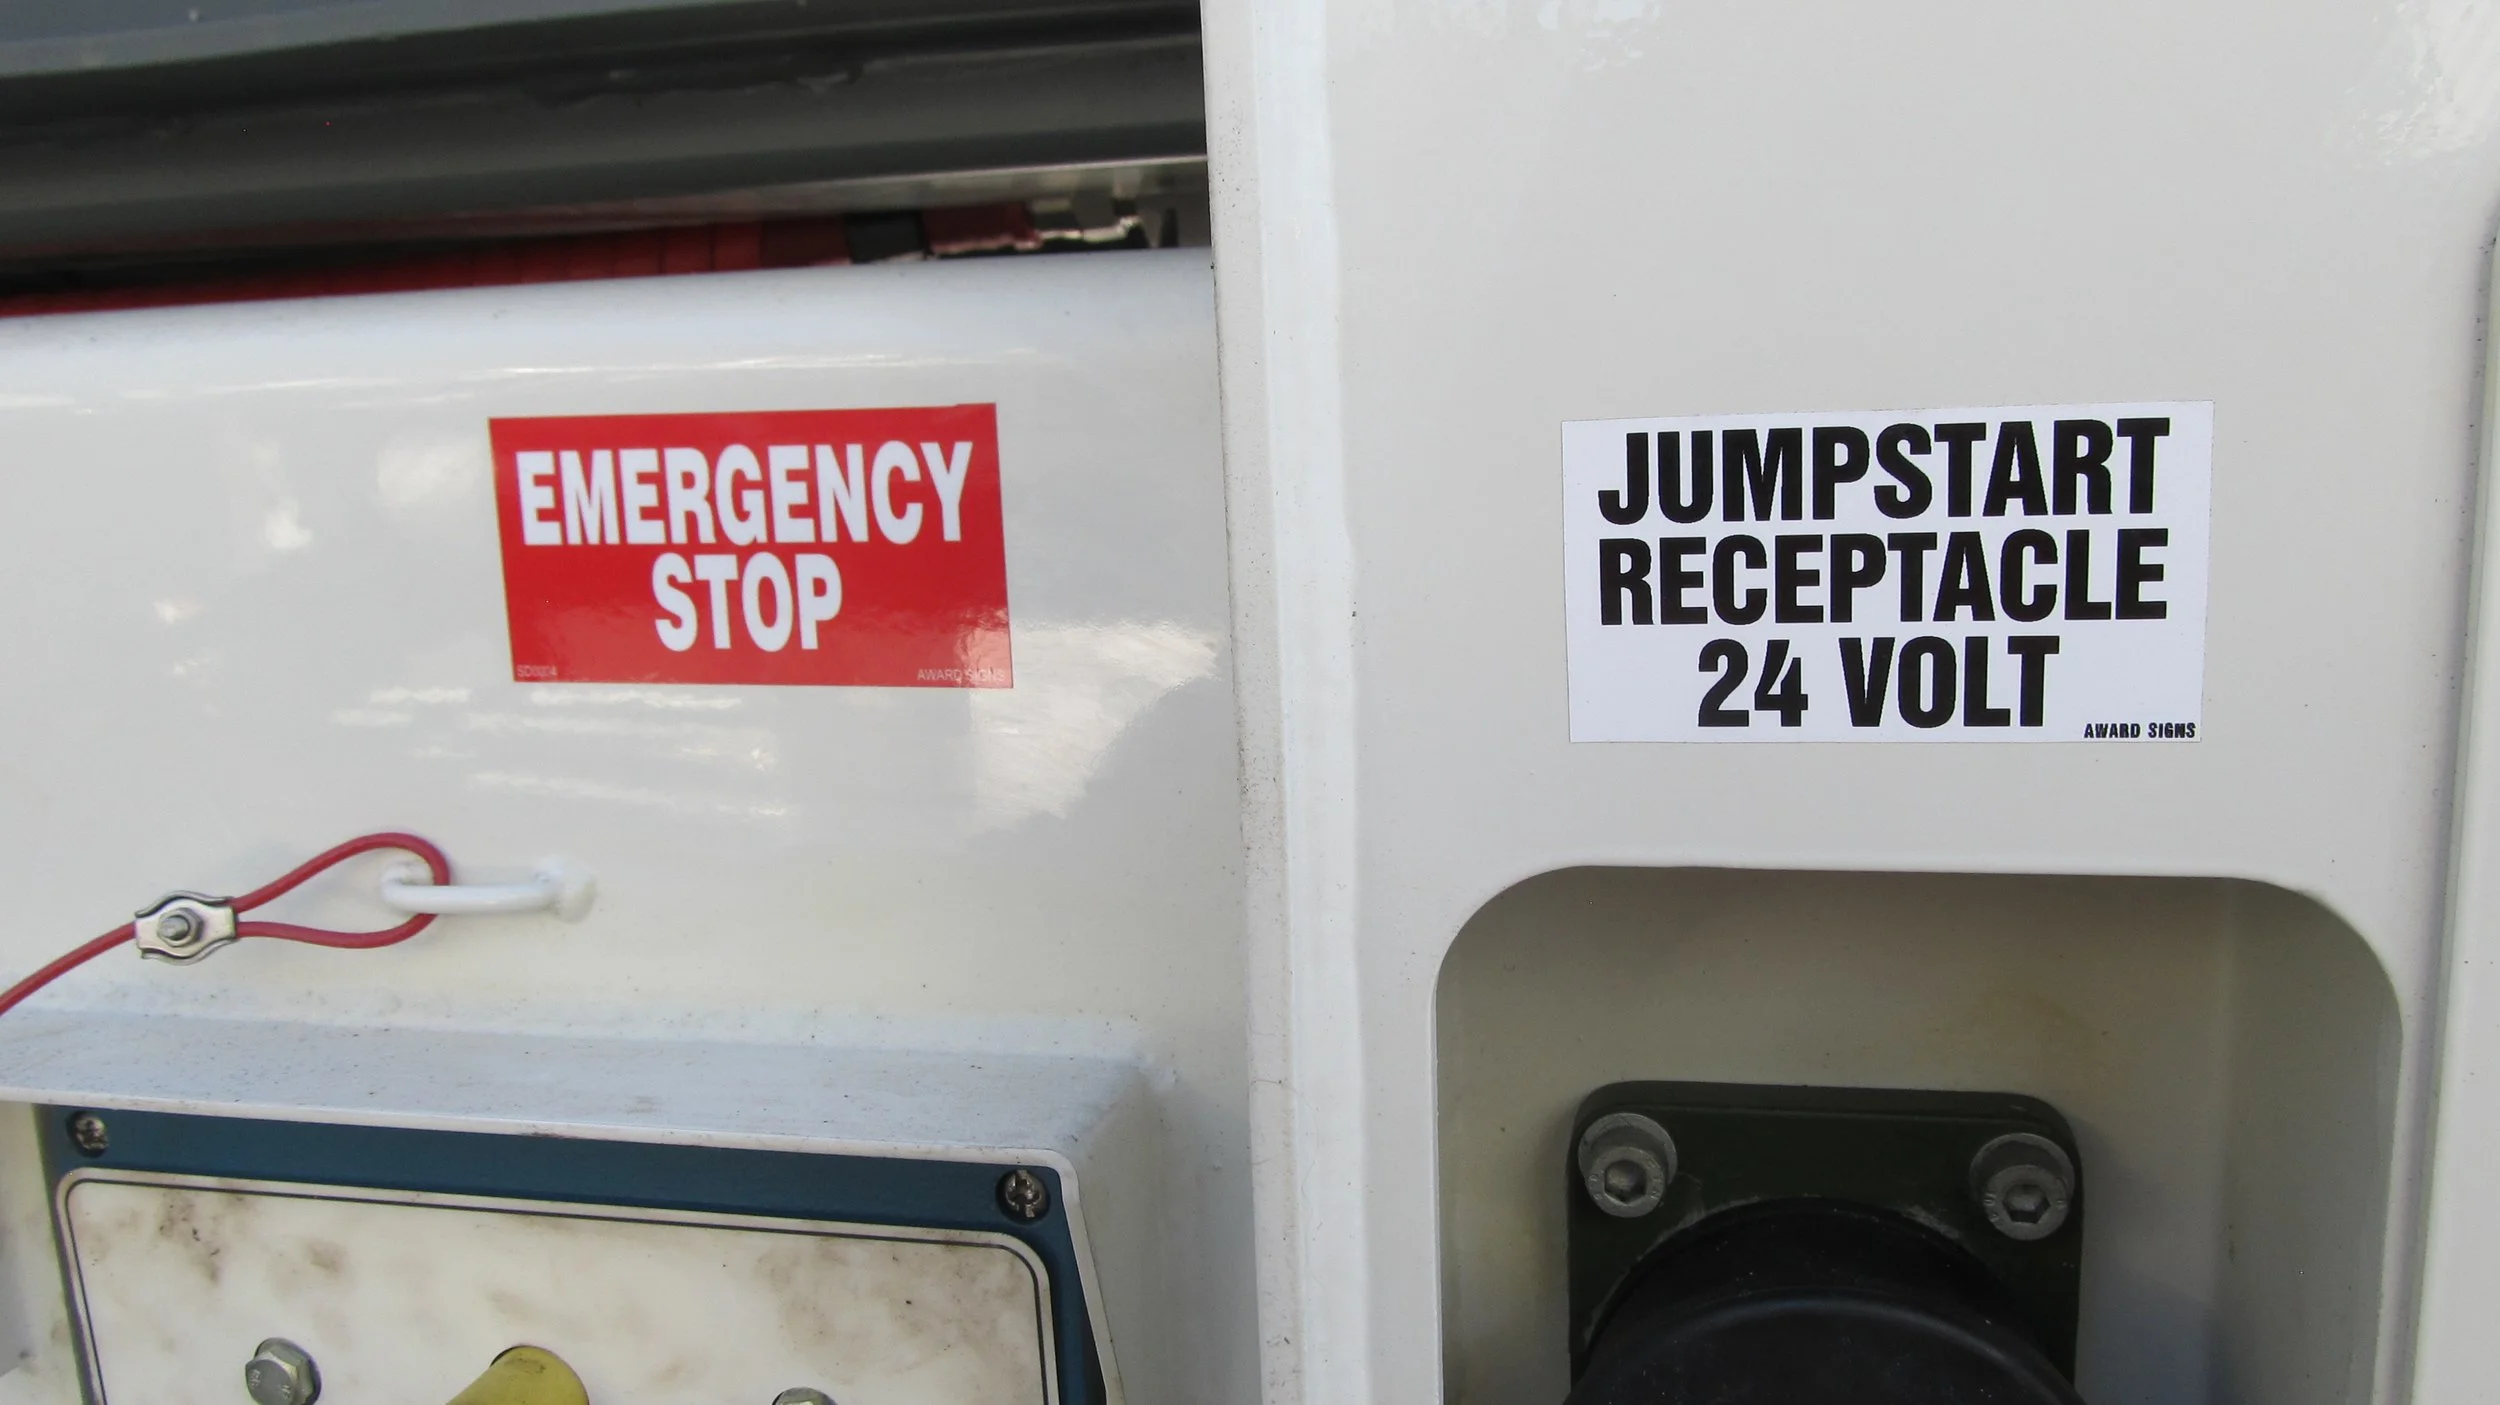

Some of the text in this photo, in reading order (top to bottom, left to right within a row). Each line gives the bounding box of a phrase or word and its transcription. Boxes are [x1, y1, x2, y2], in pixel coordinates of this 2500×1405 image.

[515, 440, 974, 546] EMERGENCY
[1598, 417, 2171, 525] JUMPSTART
[651, 551, 844, 653] STOP
[1599, 528, 2169, 626] RECEPTACLE
[917, 668, 1005, 682] AWARD SIGNS
[1697, 636, 2060, 729] 24 VOLT
[2083, 722, 2196, 739] AWARD SIGNS
